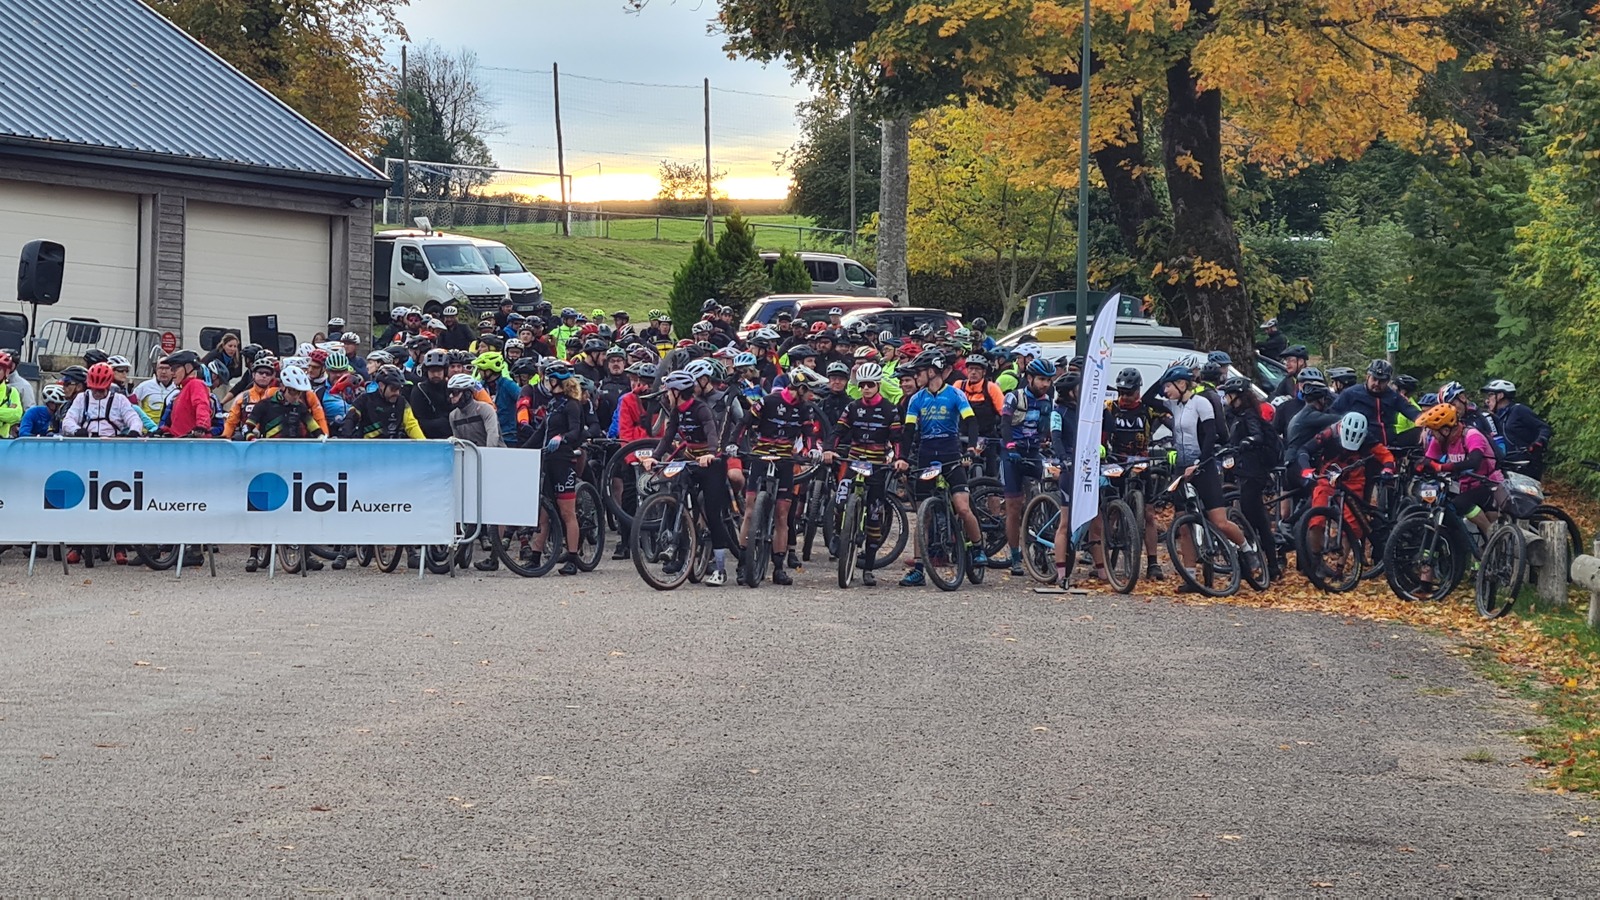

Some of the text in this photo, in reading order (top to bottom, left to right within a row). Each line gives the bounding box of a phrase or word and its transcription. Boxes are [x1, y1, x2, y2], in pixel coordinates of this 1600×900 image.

[89, 471, 207, 511] ici Auxerre
[293, 472, 412, 512] ici Auxerre
